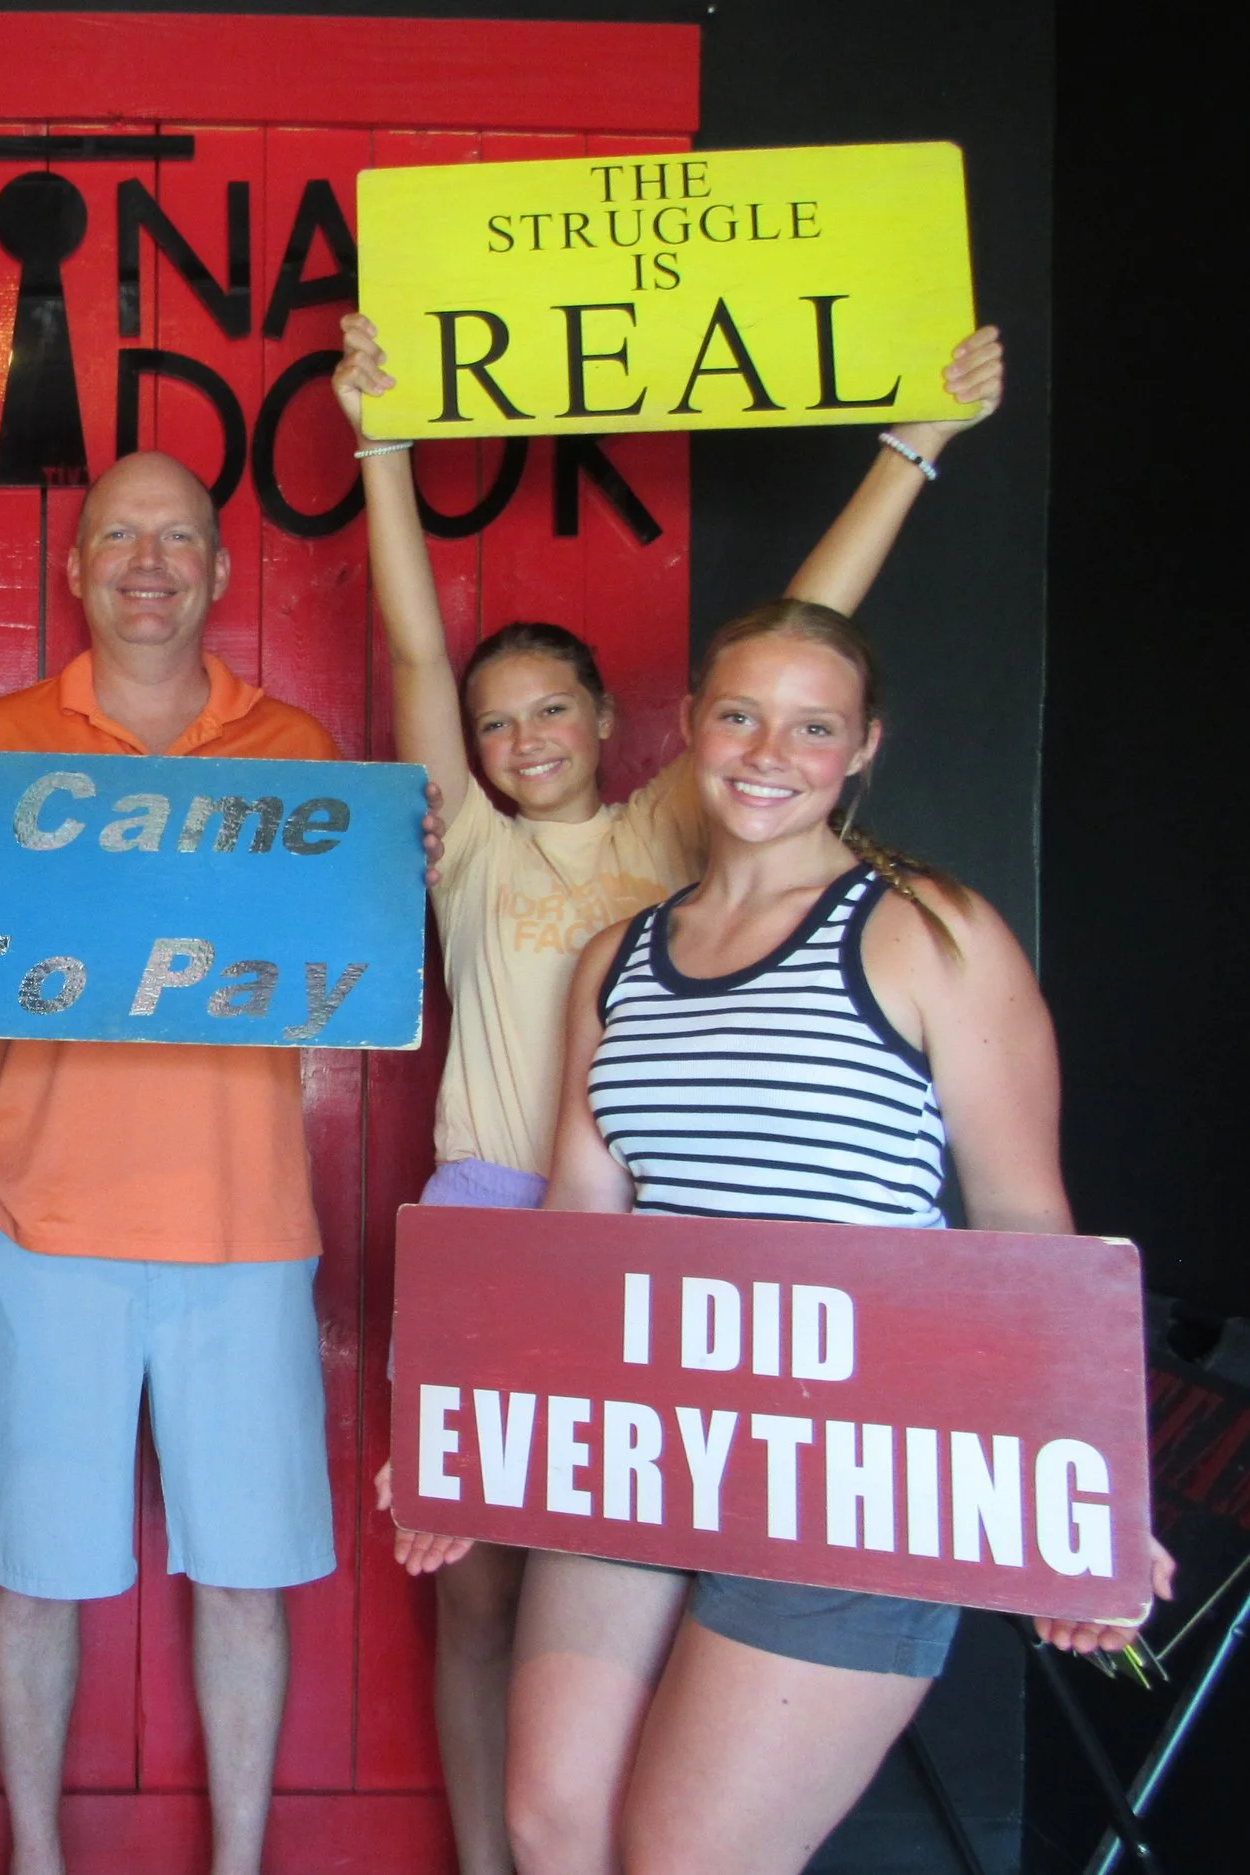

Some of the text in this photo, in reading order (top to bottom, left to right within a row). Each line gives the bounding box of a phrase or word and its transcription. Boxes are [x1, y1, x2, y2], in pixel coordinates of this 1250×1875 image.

[590, 160, 712, 203] THE
[487, 200, 822, 253] STRUGGLE
[630, 251, 682, 292] IS
[424, 294, 903, 423] REAL
[12, 771, 351, 856] Came
[514, 920, 588, 954] FAC
[128, 937, 370, 1041] Pay
[623, 1272, 855, 1382] I DID
[418, 1383, 1114, 1579] EVERYTHING
